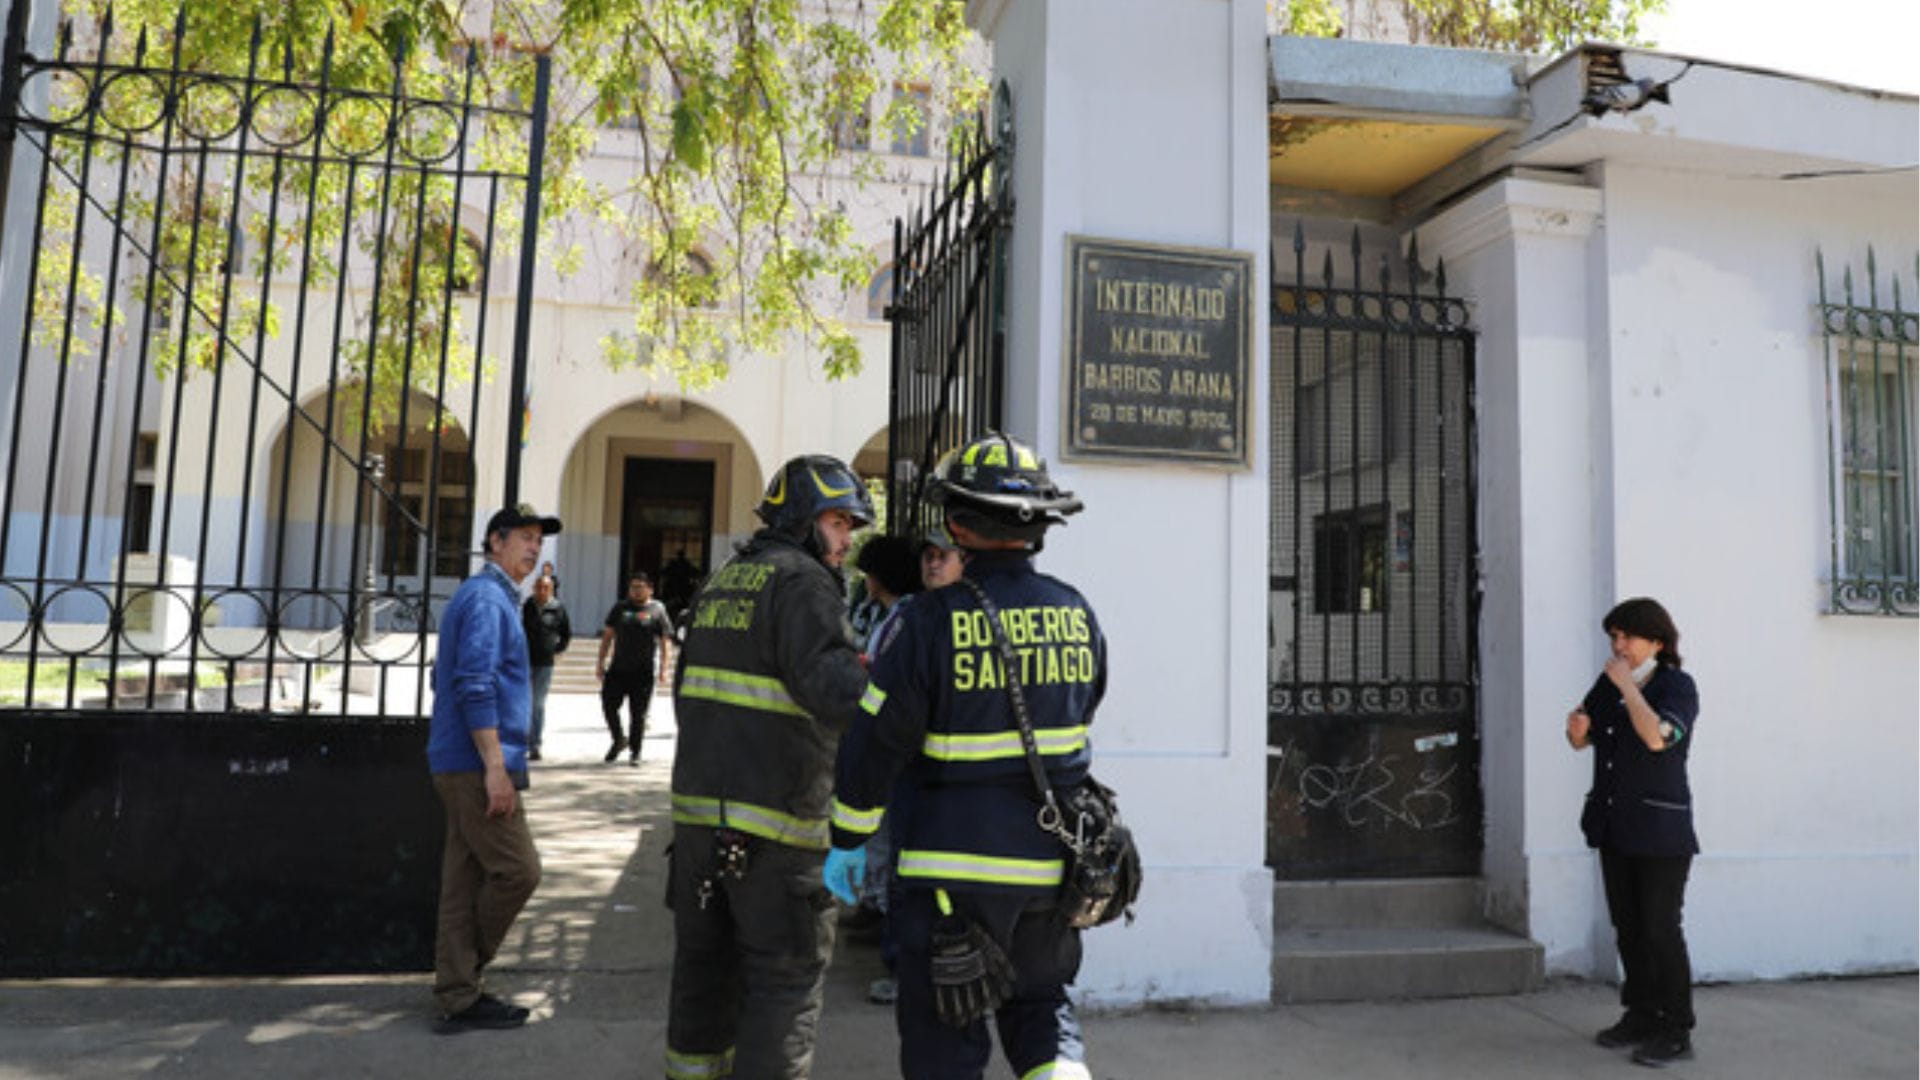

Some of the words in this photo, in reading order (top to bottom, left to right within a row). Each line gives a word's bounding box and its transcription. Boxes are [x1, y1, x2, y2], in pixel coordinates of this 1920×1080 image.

[1096, 277, 1226, 320] INTERNADO
[1110, 326, 1211, 360] NACIONAL
[1084, 362, 1162, 394] BARROS
[1169, 369, 1233, 400] ARANA
[1090, 402, 1111, 422] 20
[1115, 405, 1137, 423] DE
[1141, 406, 1185, 426] MAYO
